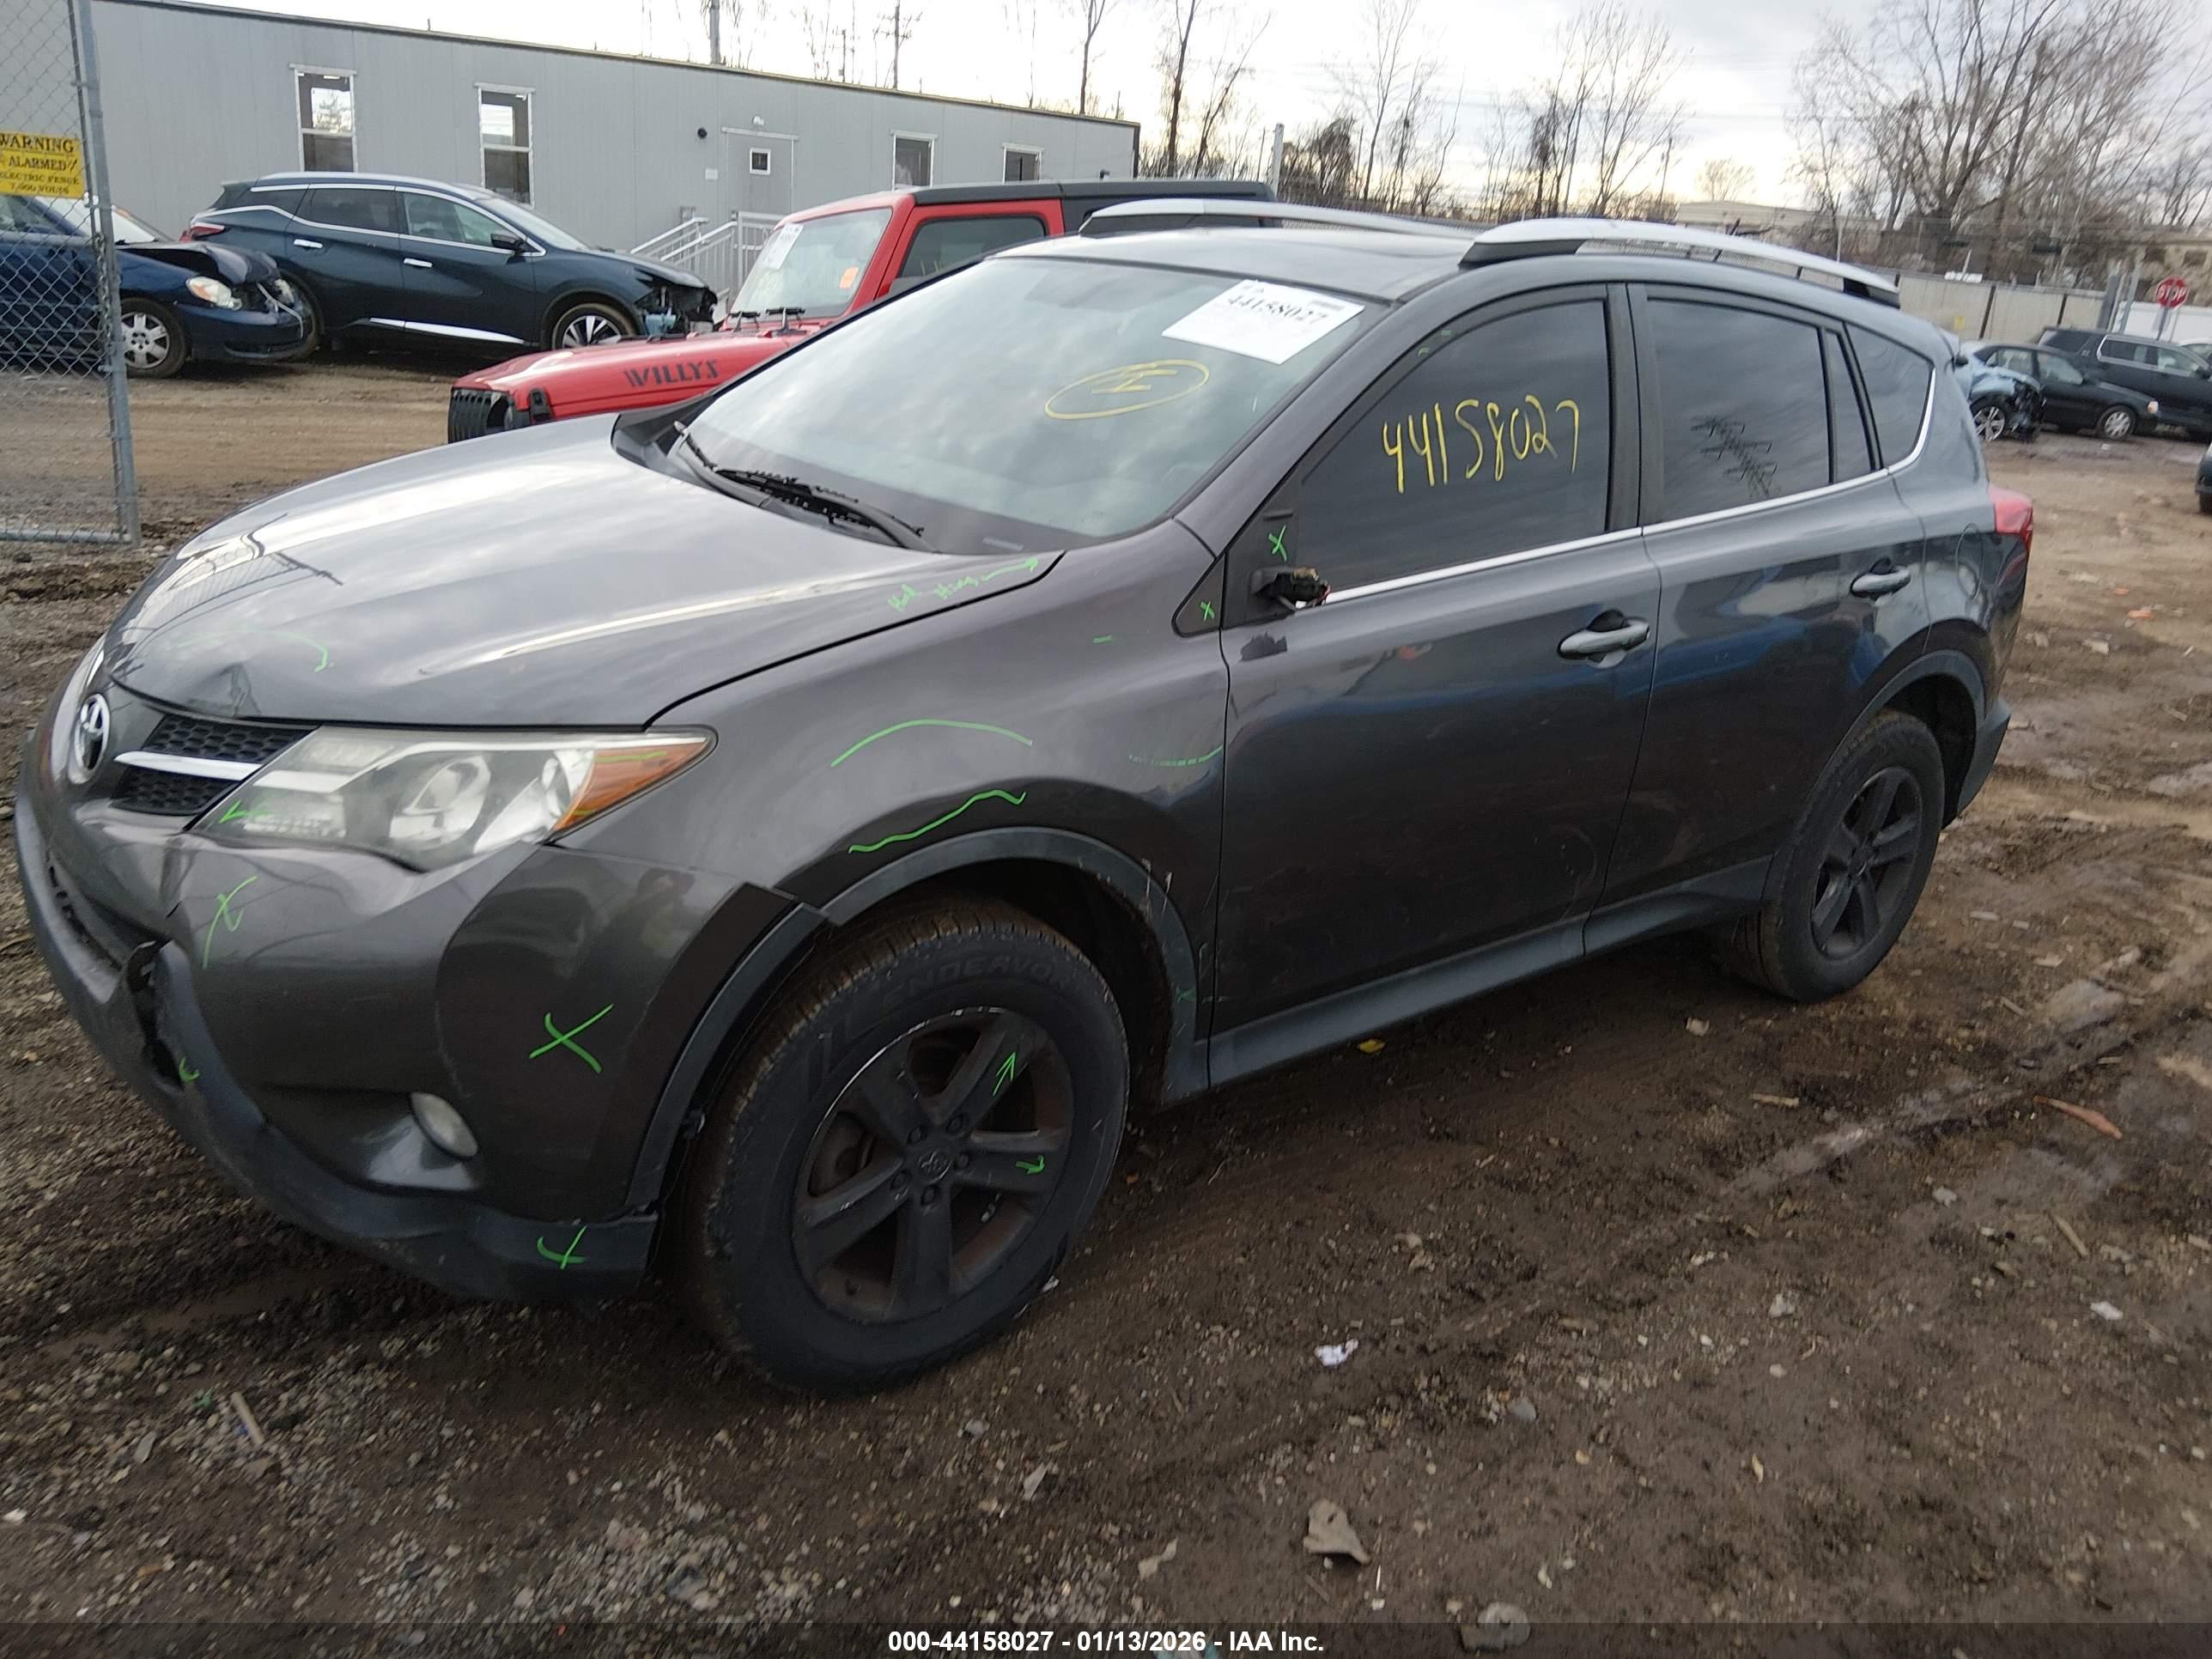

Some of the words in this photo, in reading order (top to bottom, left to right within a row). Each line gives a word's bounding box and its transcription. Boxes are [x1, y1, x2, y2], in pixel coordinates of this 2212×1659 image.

[0, 133, 75, 153] WARNING
[9, 155, 67, 172] ALARMED
[2156, 284, 2187, 300] STOP
[624, 358, 720, 388] WILLYS
[1382, 394, 1580, 495] 44158027
